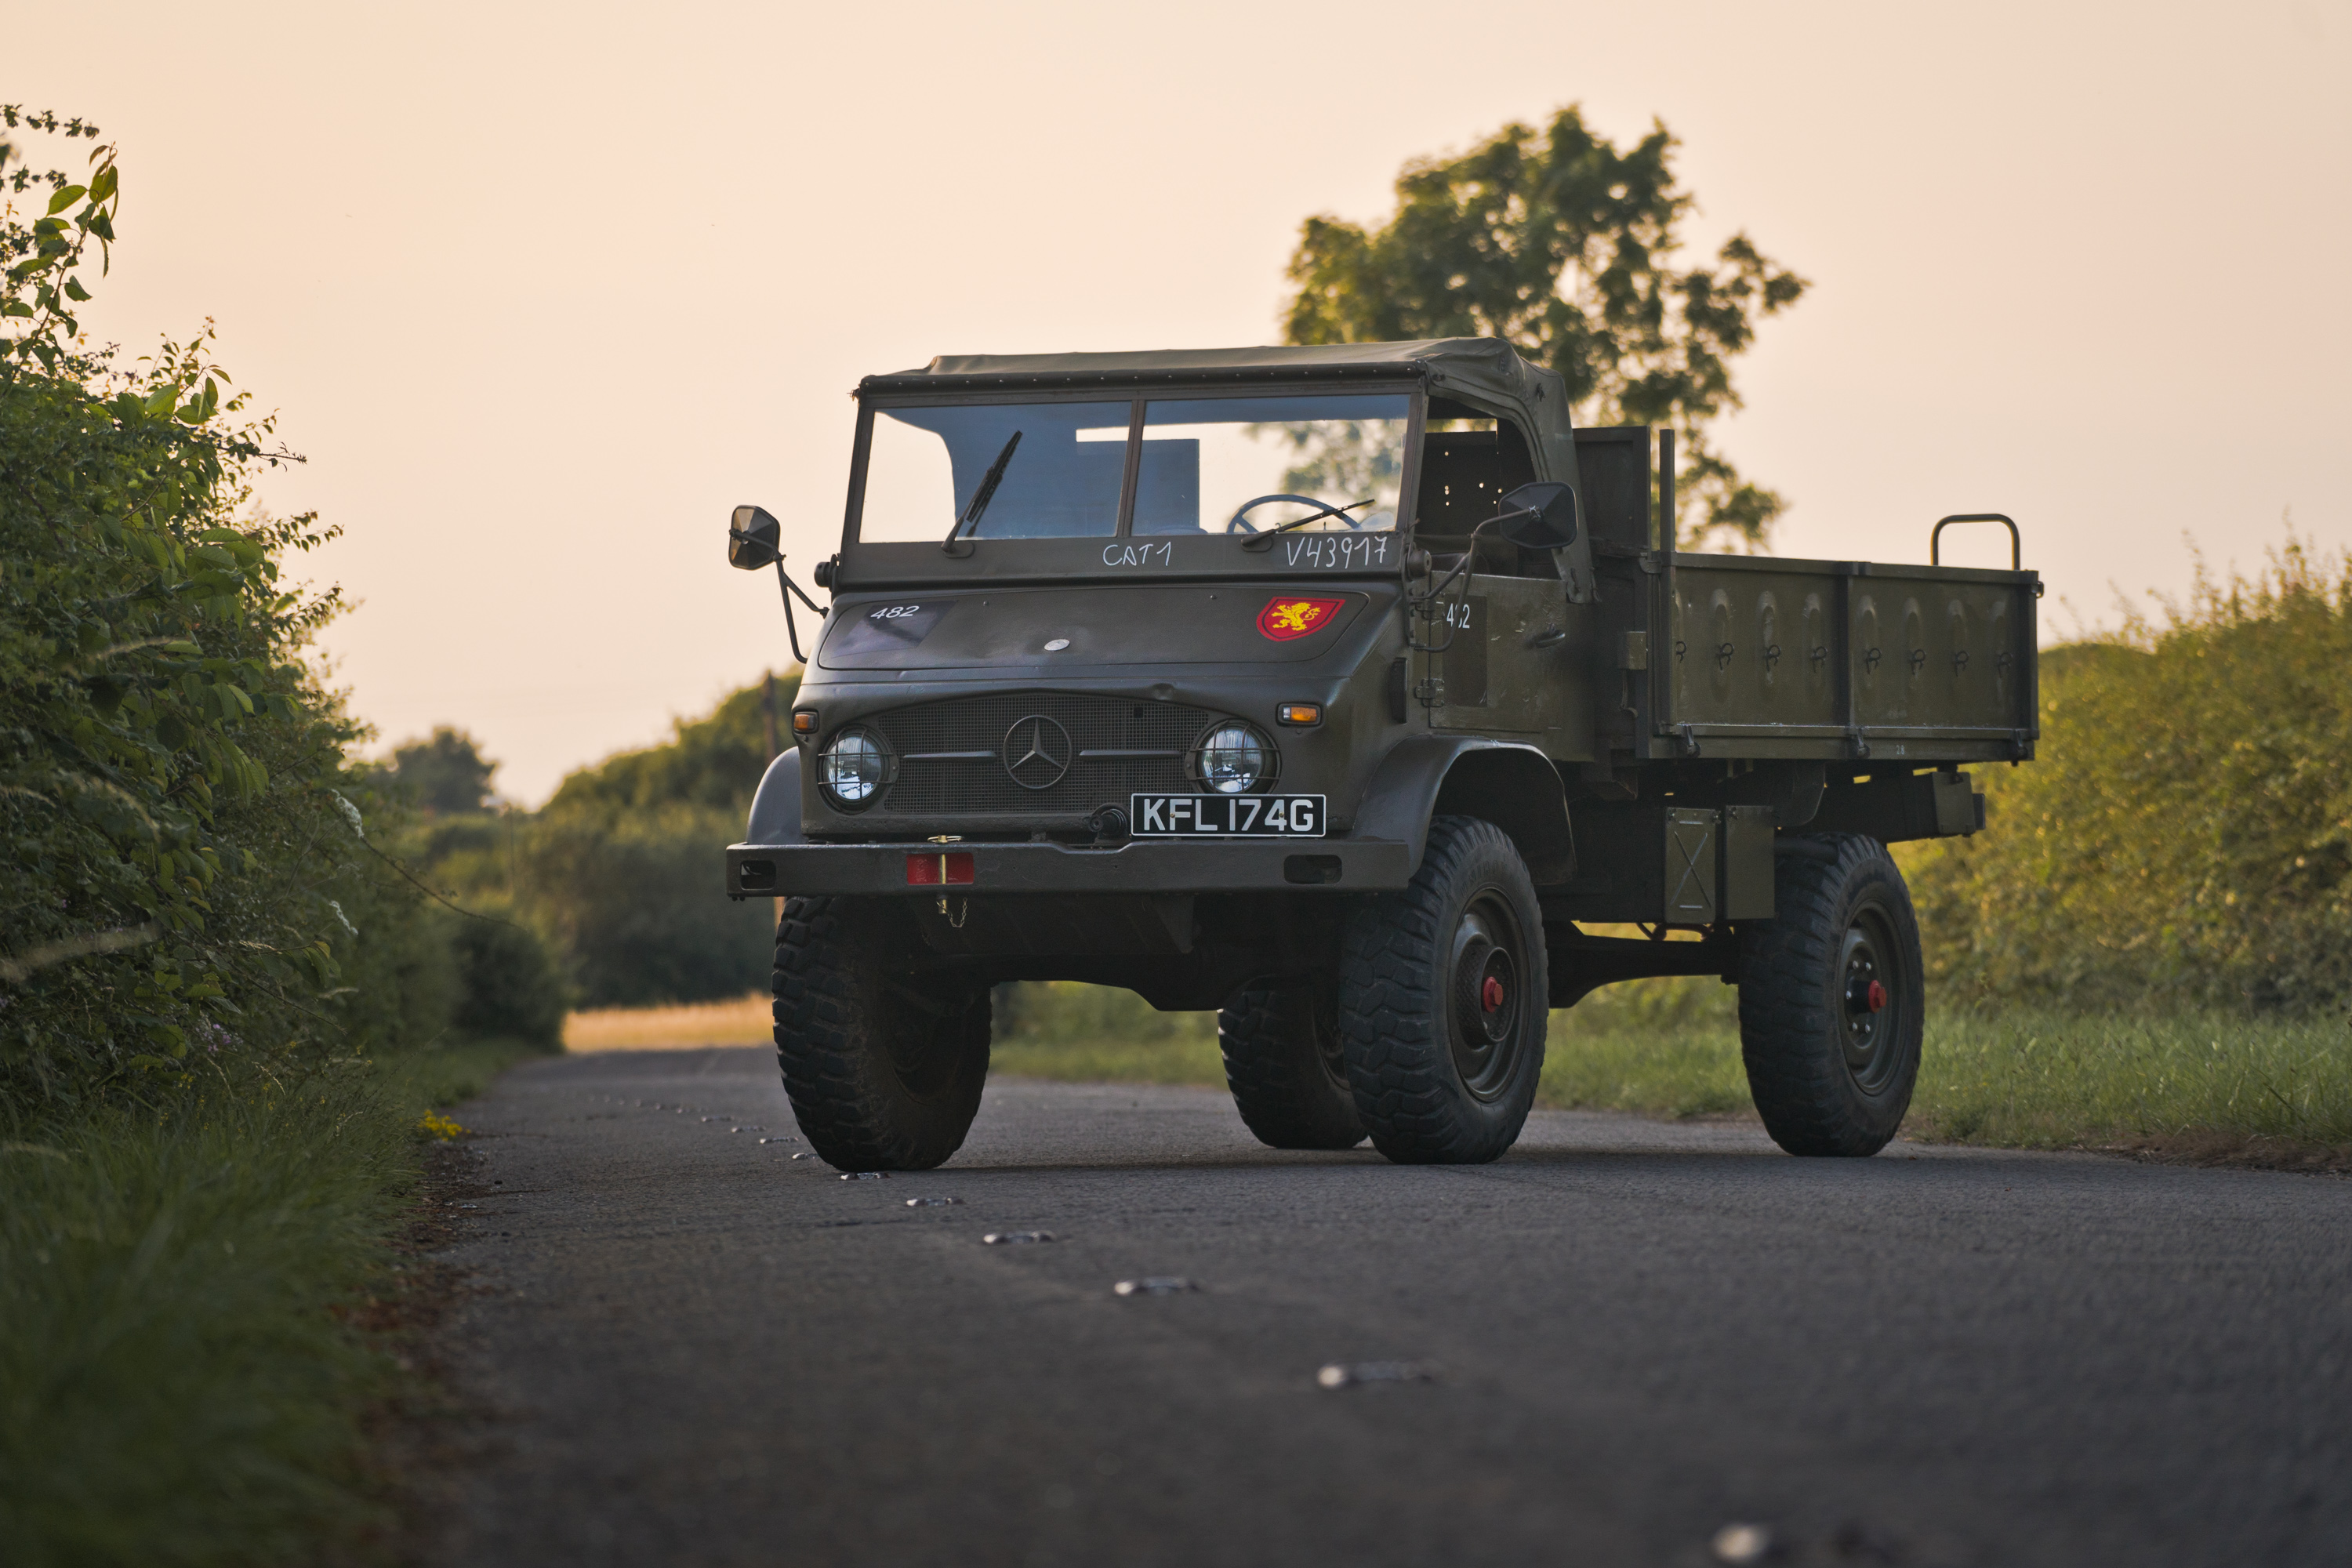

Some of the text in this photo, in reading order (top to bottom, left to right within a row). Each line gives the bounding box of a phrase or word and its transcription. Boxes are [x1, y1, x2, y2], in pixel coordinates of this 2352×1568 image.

[1287, 535, 1388, 569] V43917
[869, 604, 920, 620] 482
[1143, 798, 1314, 832] KFL 174G
